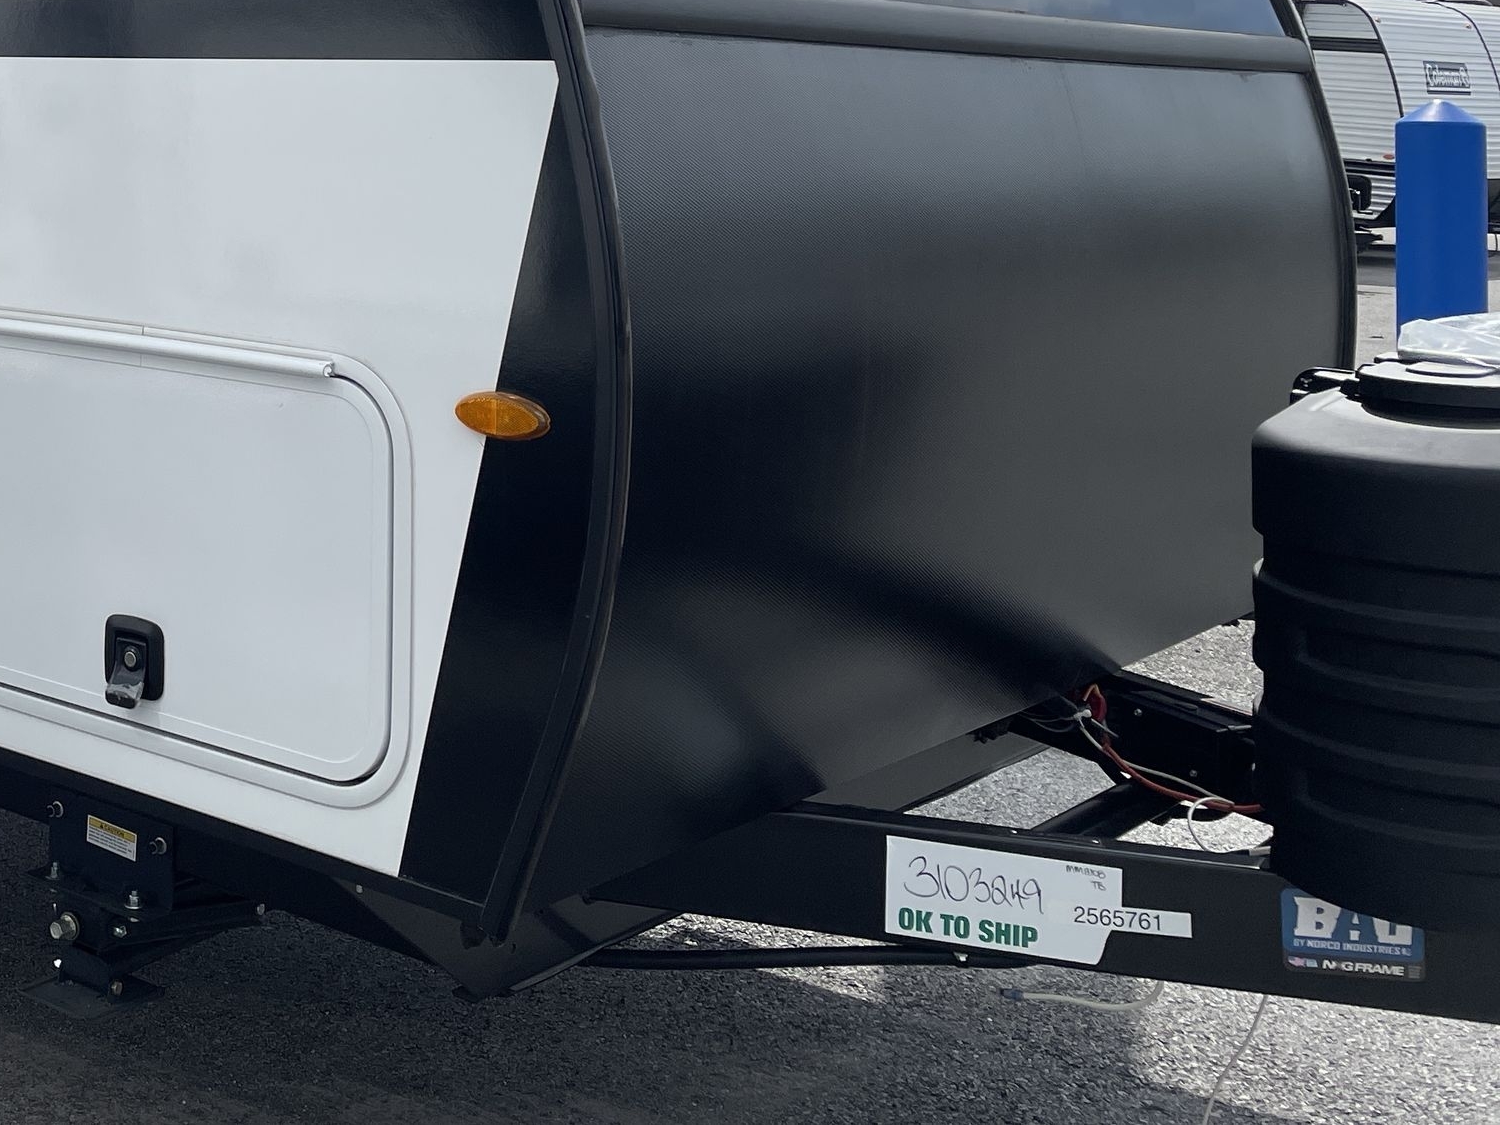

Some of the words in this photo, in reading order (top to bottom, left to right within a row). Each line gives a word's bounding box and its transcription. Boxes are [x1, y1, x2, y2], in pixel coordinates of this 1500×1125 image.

[899, 907, 933, 933] OK
[940, 913, 970, 939] TO
[978, 919, 1038, 948] SHIP
[1074, 906, 1162, 931] 2565761
[1293, 938, 1305, 947] BY
[1306, 939, 1341, 951] NORCO
[1342, 942, 1401, 956] INDUSTRIES
[1354, 962, 1405, 977] FRAME
